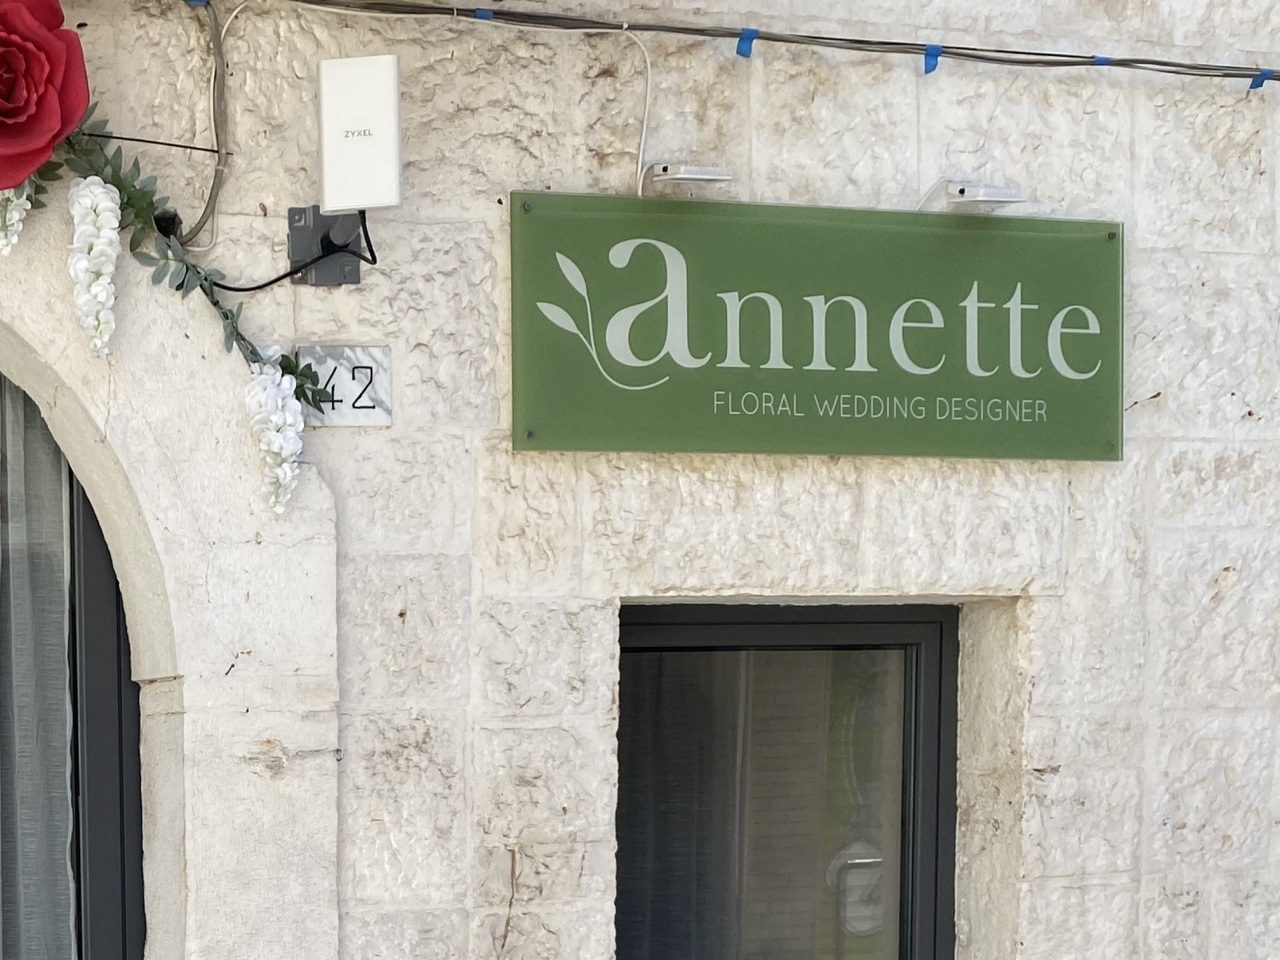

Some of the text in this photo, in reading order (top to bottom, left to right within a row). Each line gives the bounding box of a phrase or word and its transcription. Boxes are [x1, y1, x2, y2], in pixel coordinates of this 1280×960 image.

[344, 129, 373, 137] ZYXEL
[605, 238, 1102, 380] annette
[319, 365, 376, 410] 42
[713, 391, 1048, 422] FLORAL WEDDING DESIGNER
